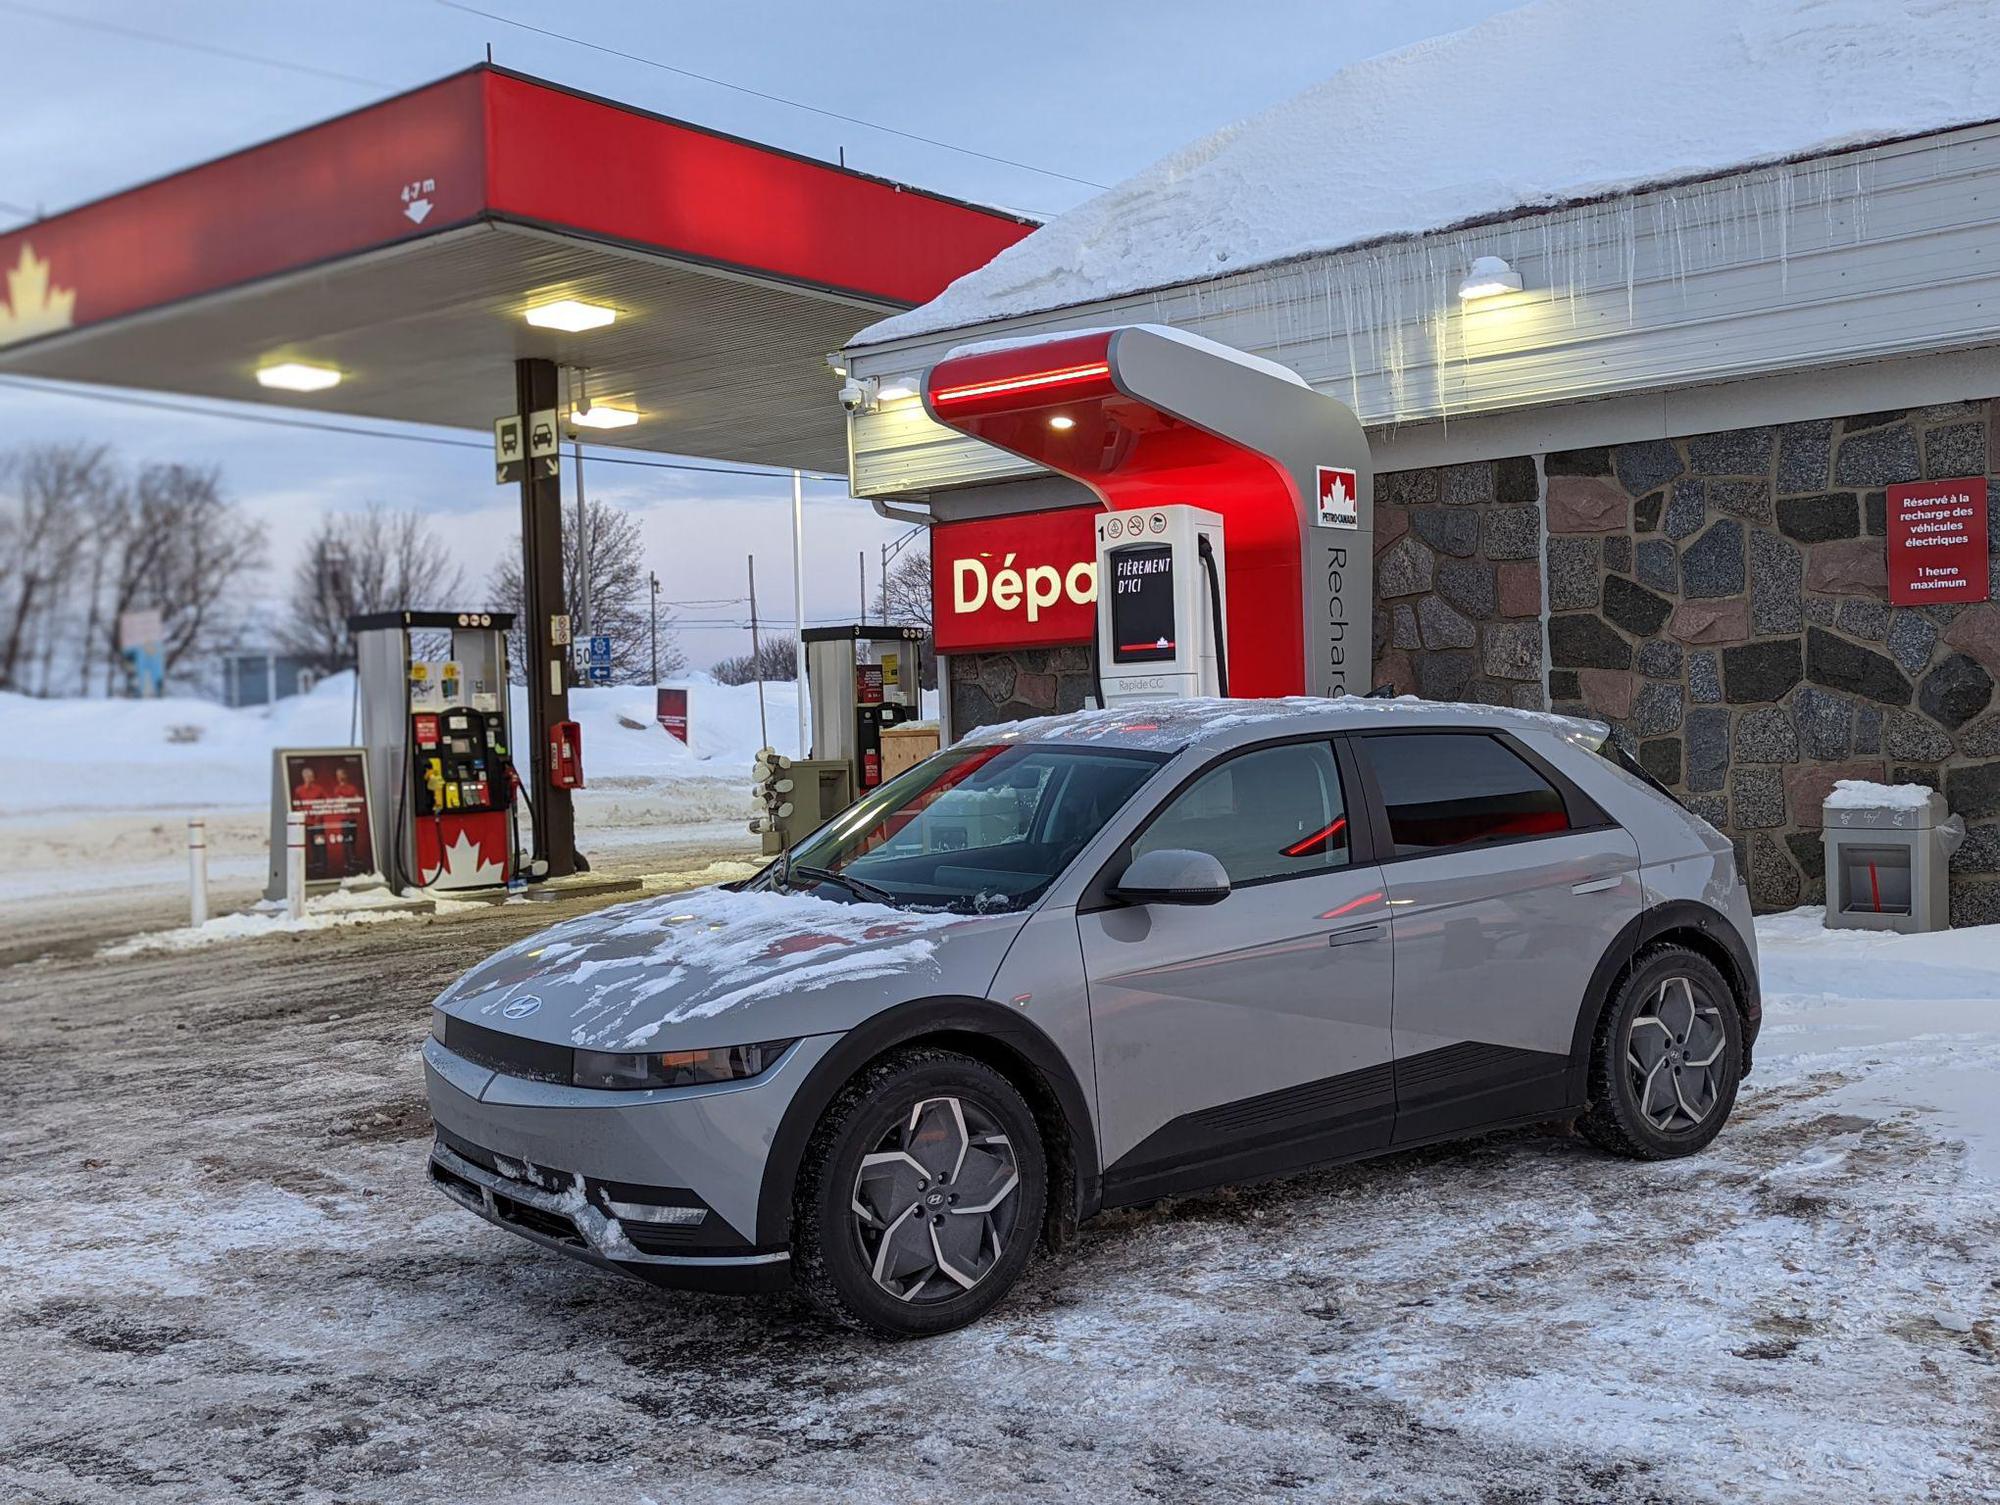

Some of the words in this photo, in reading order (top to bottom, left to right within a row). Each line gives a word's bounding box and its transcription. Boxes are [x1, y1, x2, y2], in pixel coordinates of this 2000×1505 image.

[1903, 495, 1948, 507] Réservé
[1950, 494, 1957, 503] à
[1960, 493, 1969, 503] la
[1900, 509, 1950, 521] recharge
[1952, 507, 1973, 517] des
[1098, 526, 1104, 541] 1
[1910, 522, 1963, 533] véhicules
[1905, 535, 1968, 546] électriques
[1117, 558, 1171, 577] FIÈREMENT
[1918, 567, 1923, 577] 1
[1925, 566, 1958, 576] heure
[953, 553, 1098, 622] Dépa
[1118, 578, 1141, 594] D'ICI
[1910, 578, 1967, 590] maximum
[854, 626, 860, 636] 3
[576, 647, 591, 666] 50
[1119, 679, 1148, 692] Rapide
